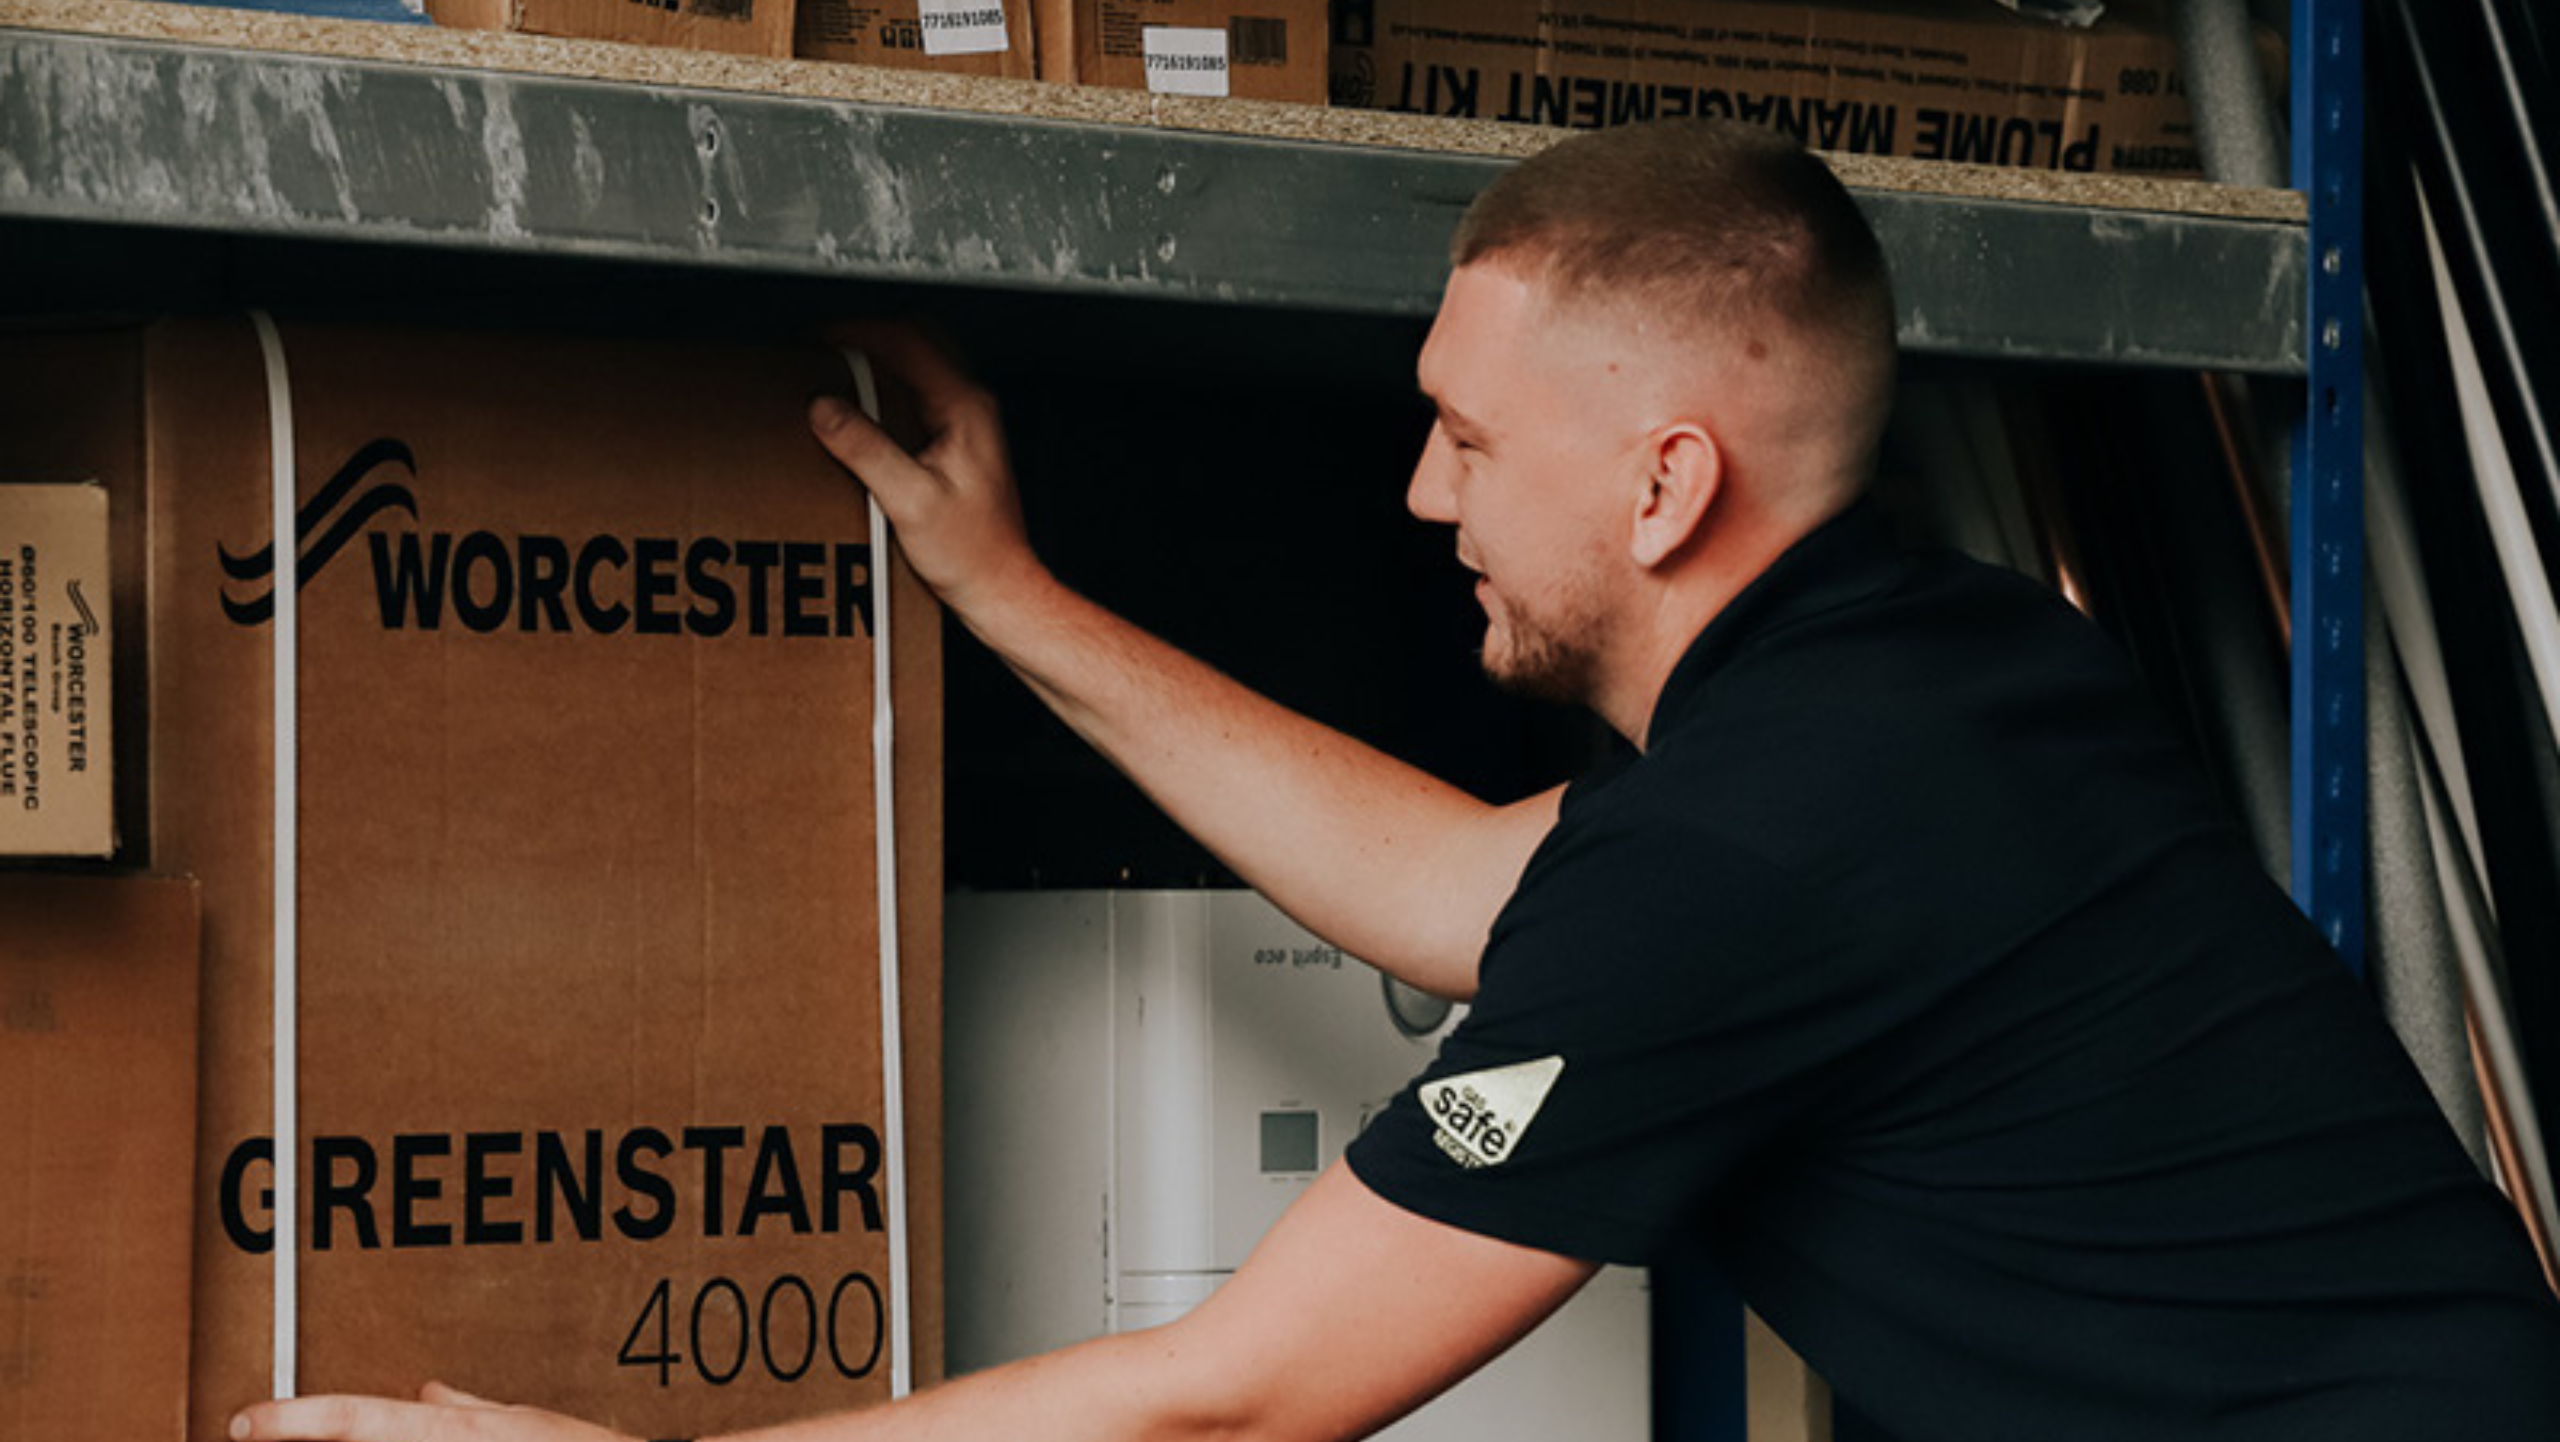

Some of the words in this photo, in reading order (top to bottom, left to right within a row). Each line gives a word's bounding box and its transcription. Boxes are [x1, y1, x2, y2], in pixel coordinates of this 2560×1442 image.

[923, 9, 1002, 29] 7716191085
[1386, 61, 1479, 118] KIT
[1912, 107, 2100, 172] PLUME
[367, 530, 875, 638] WORCESTER
[0, 559, 14, 723] HORIZONTAL
[21, 652, 39, 810] TELESCOPIC
[67, 623, 87, 773] WORCESTER
[1, 732, 16, 797] FLUE
[1253, 948, 1287, 965] eco
[1433, 1086, 1506, 1157] safe
[219, 1122, 885, 1254] GREENSTAR
[616, 1271, 885, 1387] 4000
